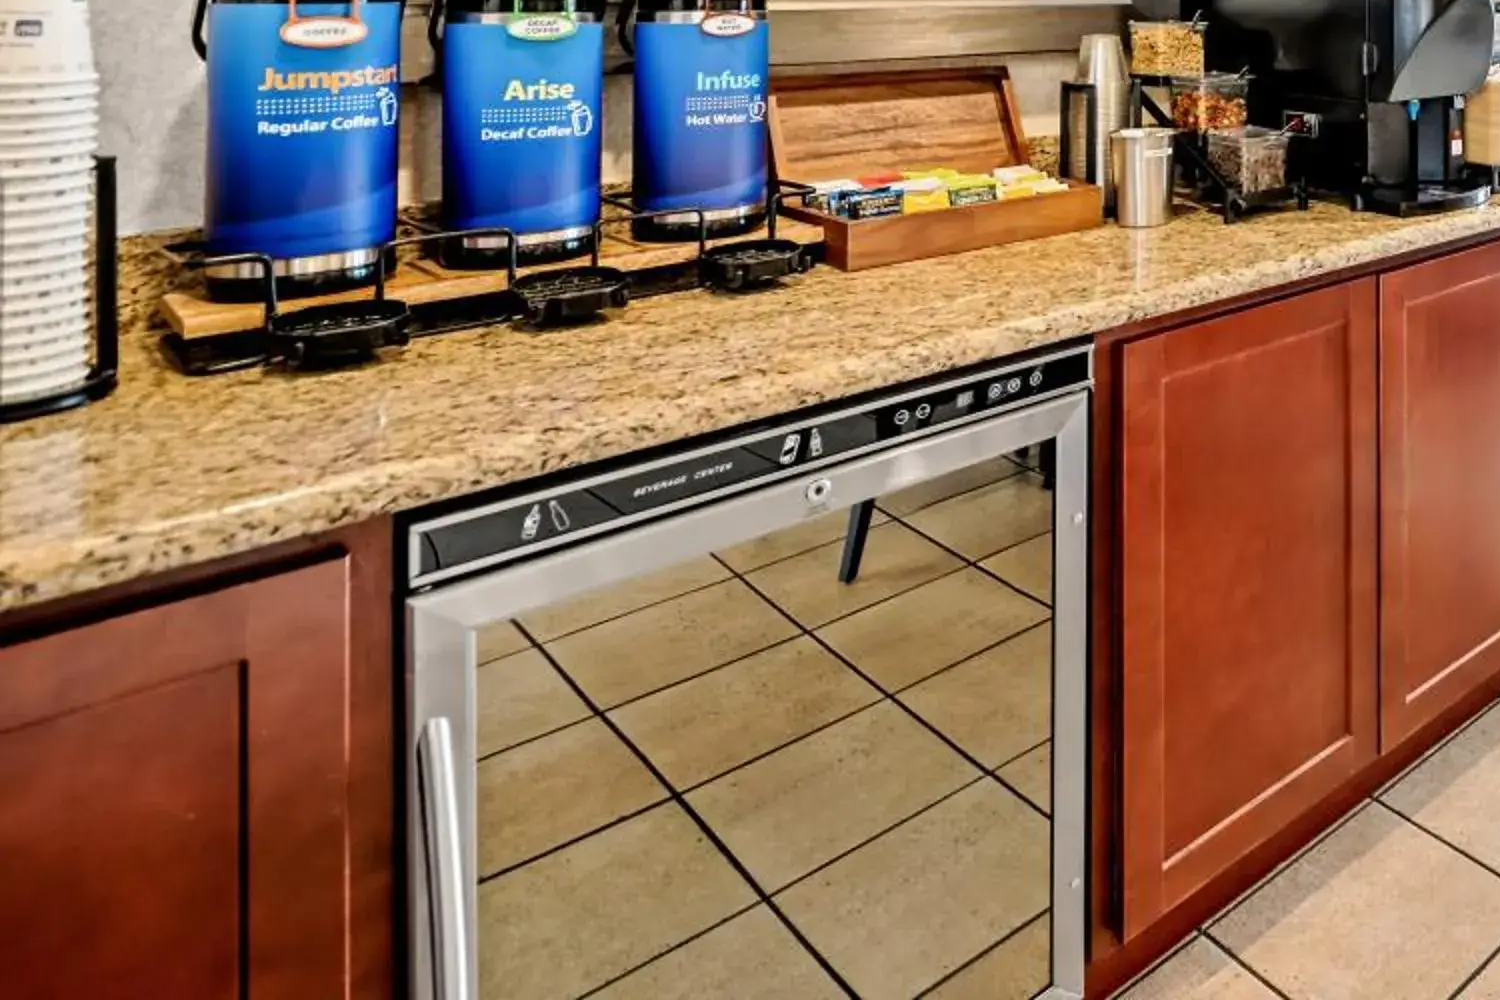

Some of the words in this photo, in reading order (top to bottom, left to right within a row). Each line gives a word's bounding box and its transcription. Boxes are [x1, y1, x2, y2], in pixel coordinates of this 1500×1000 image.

[503, 78, 576, 101] Arise
[696, 69, 761, 91] Infuse
[257, 119, 328, 137] Regular
[330, 115, 380, 130] Coffee
[686, 114, 711, 126] Hot
[713, 113, 748, 125] Water
[481, 127, 525, 140] Decaf
[527, 125, 573, 138] Coffee
[633, 475, 688, 498] BEVERAGE
[693, 462, 733, 480] CENTER
